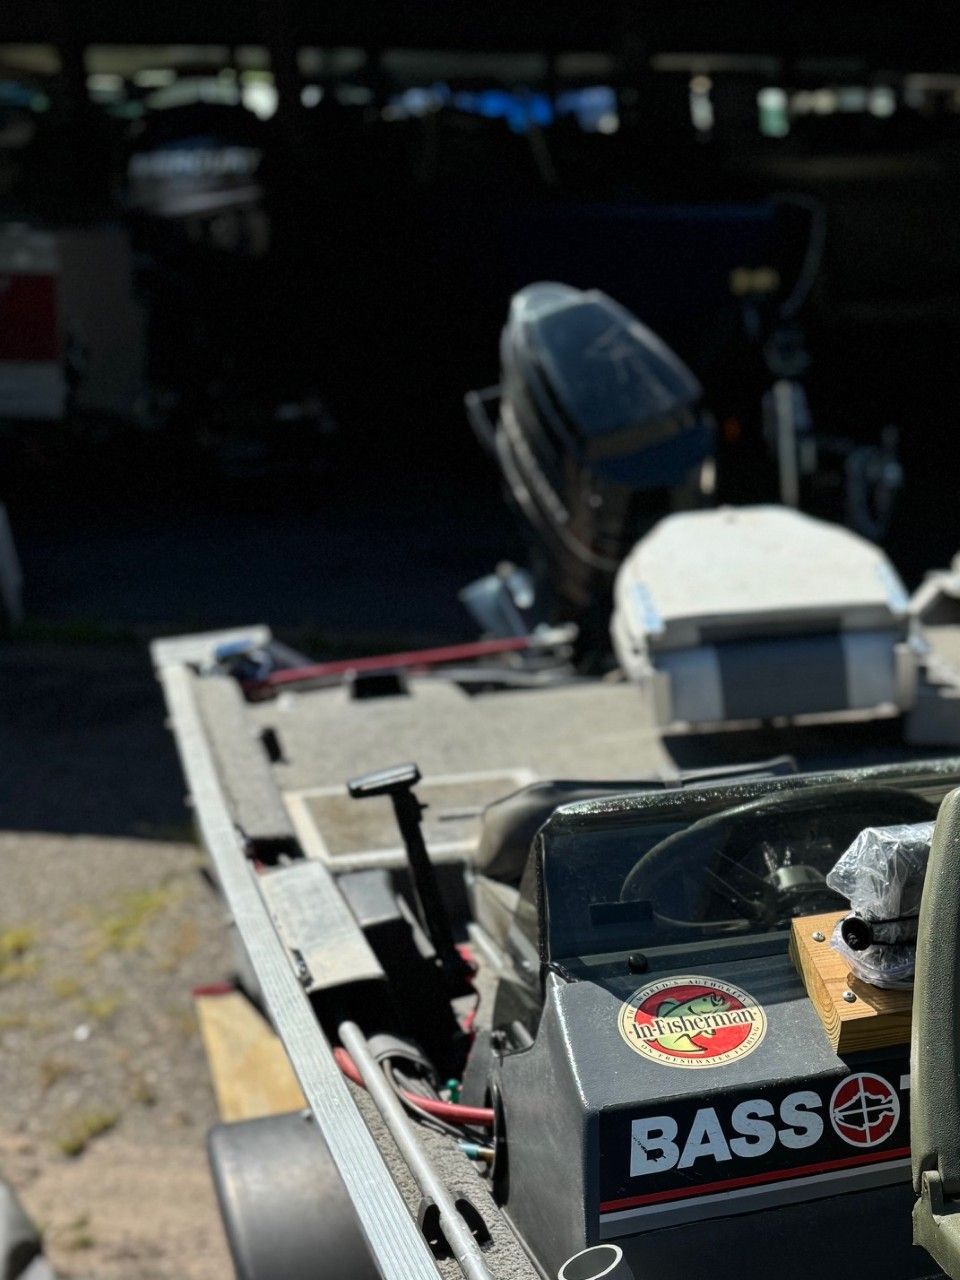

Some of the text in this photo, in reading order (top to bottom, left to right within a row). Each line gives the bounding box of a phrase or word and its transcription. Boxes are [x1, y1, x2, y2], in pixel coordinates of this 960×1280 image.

[688, 979, 747, 1003] AUTHORITY
[632, 1009, 756, 1039] In-Fisherman
[658, 1053, 730, 1064] FRESHWATER
[734, 1026, 760, 1055] FISHING
[630, 1090, 824, 1177] BASS
